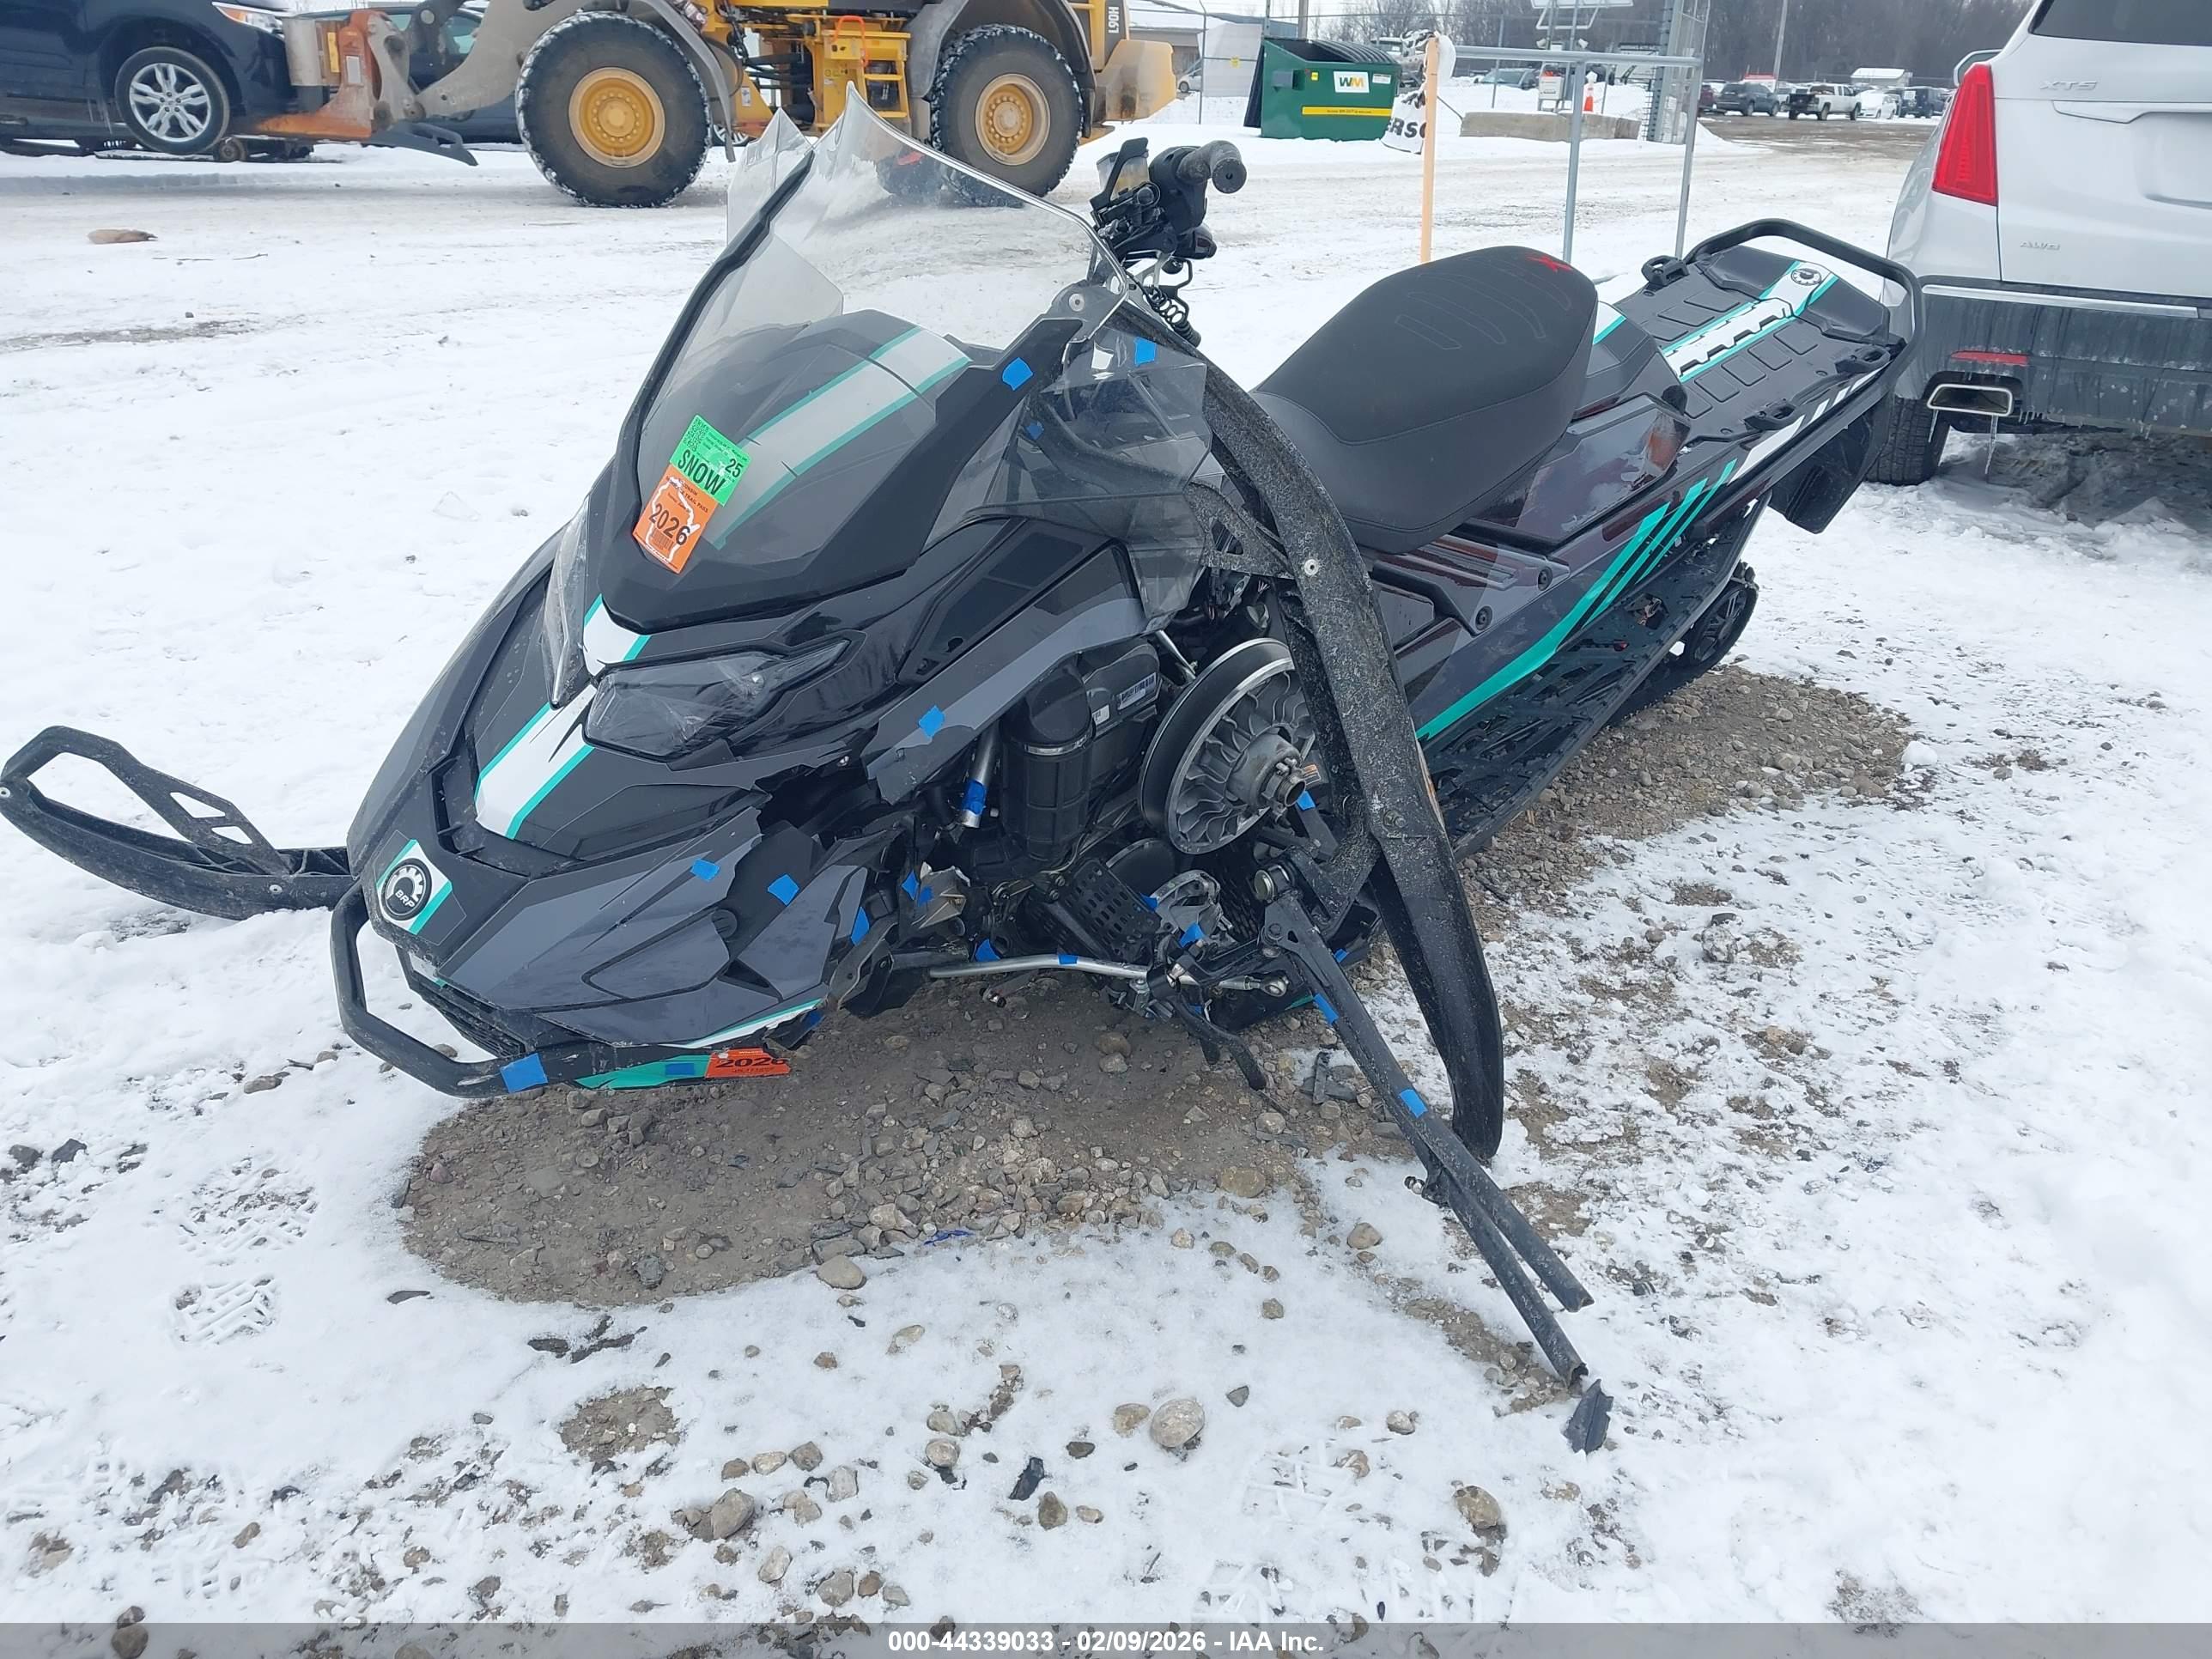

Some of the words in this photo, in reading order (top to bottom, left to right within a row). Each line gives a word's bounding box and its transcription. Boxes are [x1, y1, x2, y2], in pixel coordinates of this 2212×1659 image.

[1108, 6, 1120, 33] L90H
[1340, 76, 1364, 87] WM
[678, 449, 727, 495] SNOW
[725, 458, 744, 478] 25
[648, 503, 690, 545] 2026
[395, 890, 415, 908] BRP
